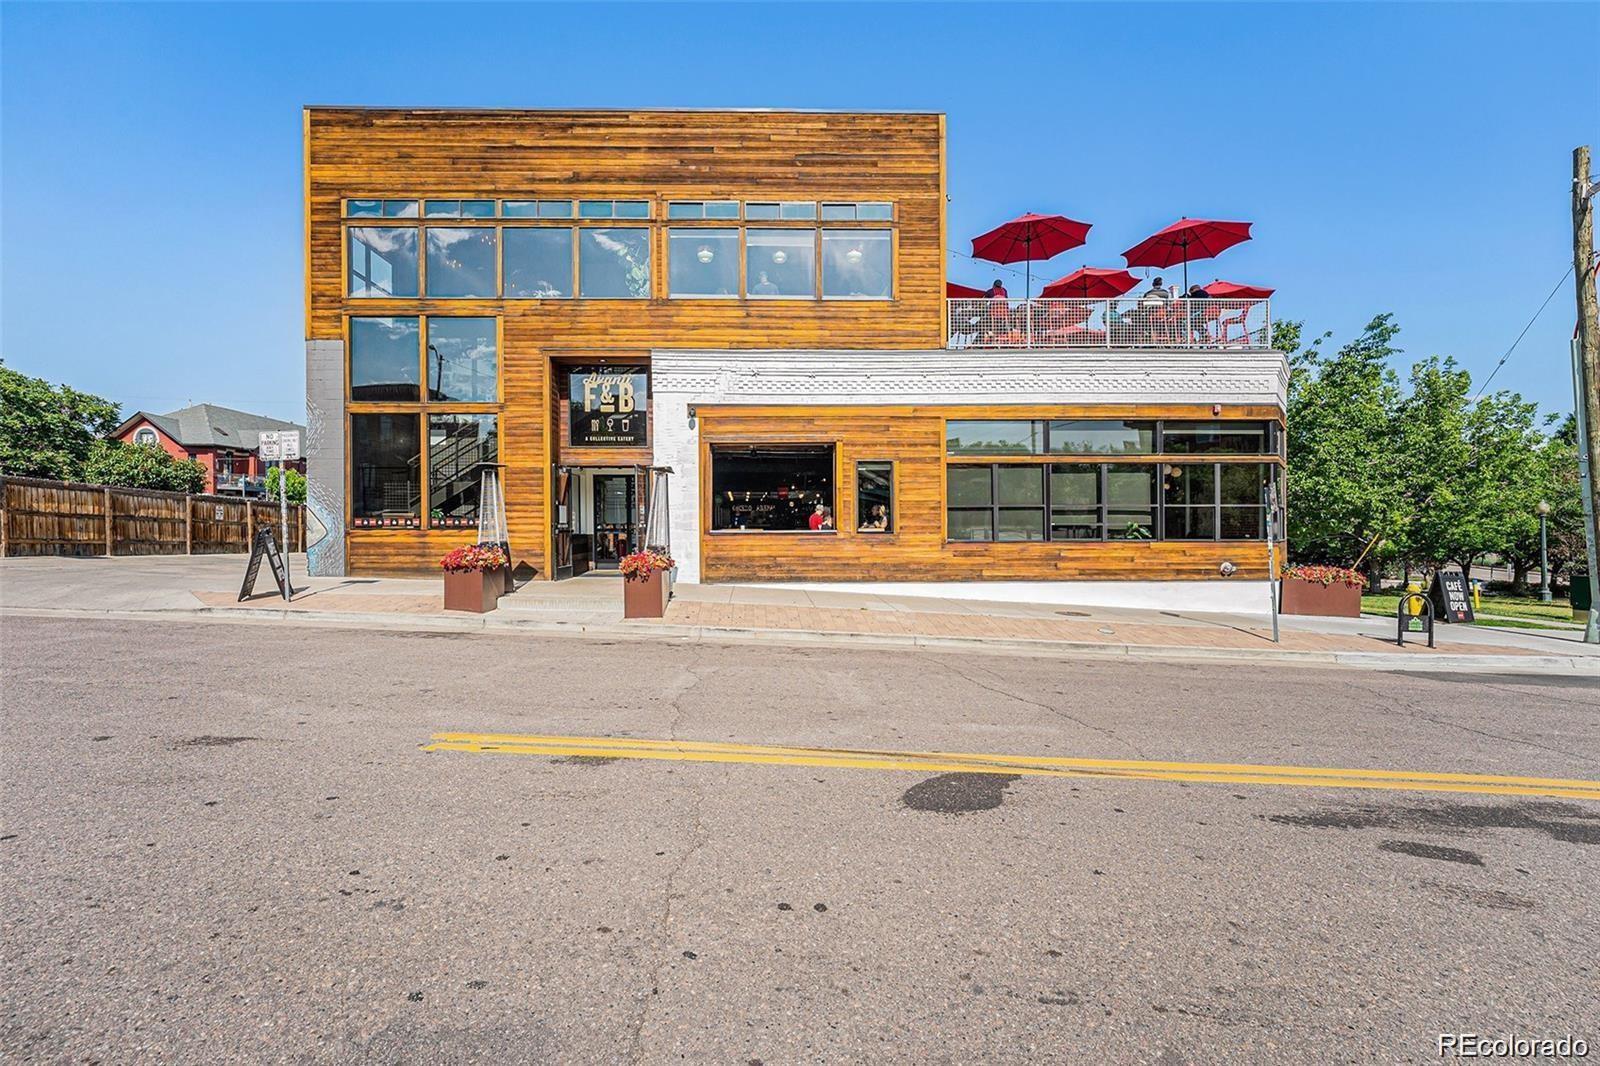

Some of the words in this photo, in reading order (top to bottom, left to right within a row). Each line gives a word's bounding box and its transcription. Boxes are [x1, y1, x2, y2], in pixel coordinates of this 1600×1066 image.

[583, 372, 632, 385] Avanti
[1445, 580, 1463, 591] CAFÉ
[1449, 591, 1465, 601] NOW
[1449, 601, 1468, 612] OPEN
